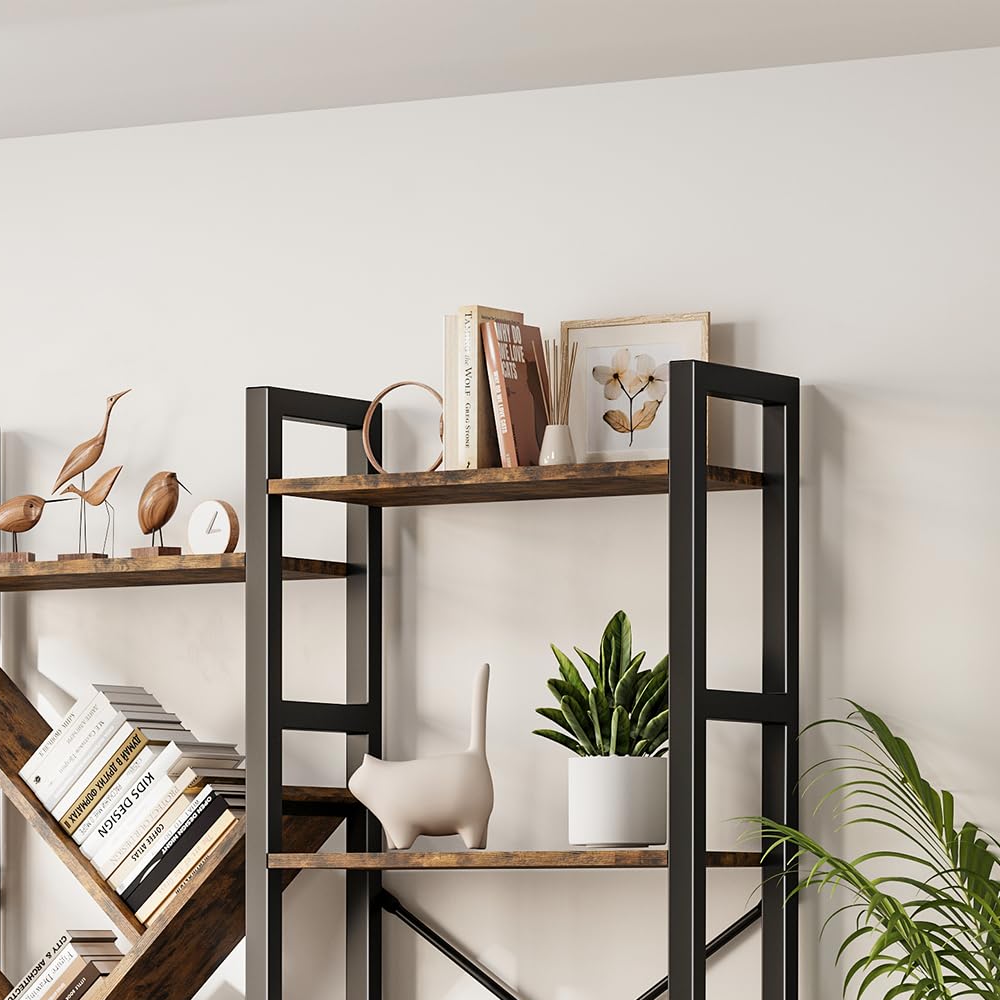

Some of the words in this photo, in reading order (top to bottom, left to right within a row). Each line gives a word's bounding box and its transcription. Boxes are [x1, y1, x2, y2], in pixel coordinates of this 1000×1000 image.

[509, 344, 525, 363] LOVE
[502, 361, 518, 380] CATS
[118, 733, 143, 760] ДУМАЙ
[114, 757, 124, 766] В
[93, 762, 119, 790] ДРУГИХ
[129, 771, 155, 799] KIDS
[66, 787, 99, 822] ФОРМАТАХ
[195, 795, 212, 813] OPEN
[96, 796, 134, 838] DESIGN
[176, 812, 198, 835] DESIGN
[144, 822, 165, 845] COFFEE
[160, 833, 178, 854] NIGHT
[130, 842, 148, 861] ATLAS
[50, 934, 67, 953] CITY
[44, 951, 53, 959] &
